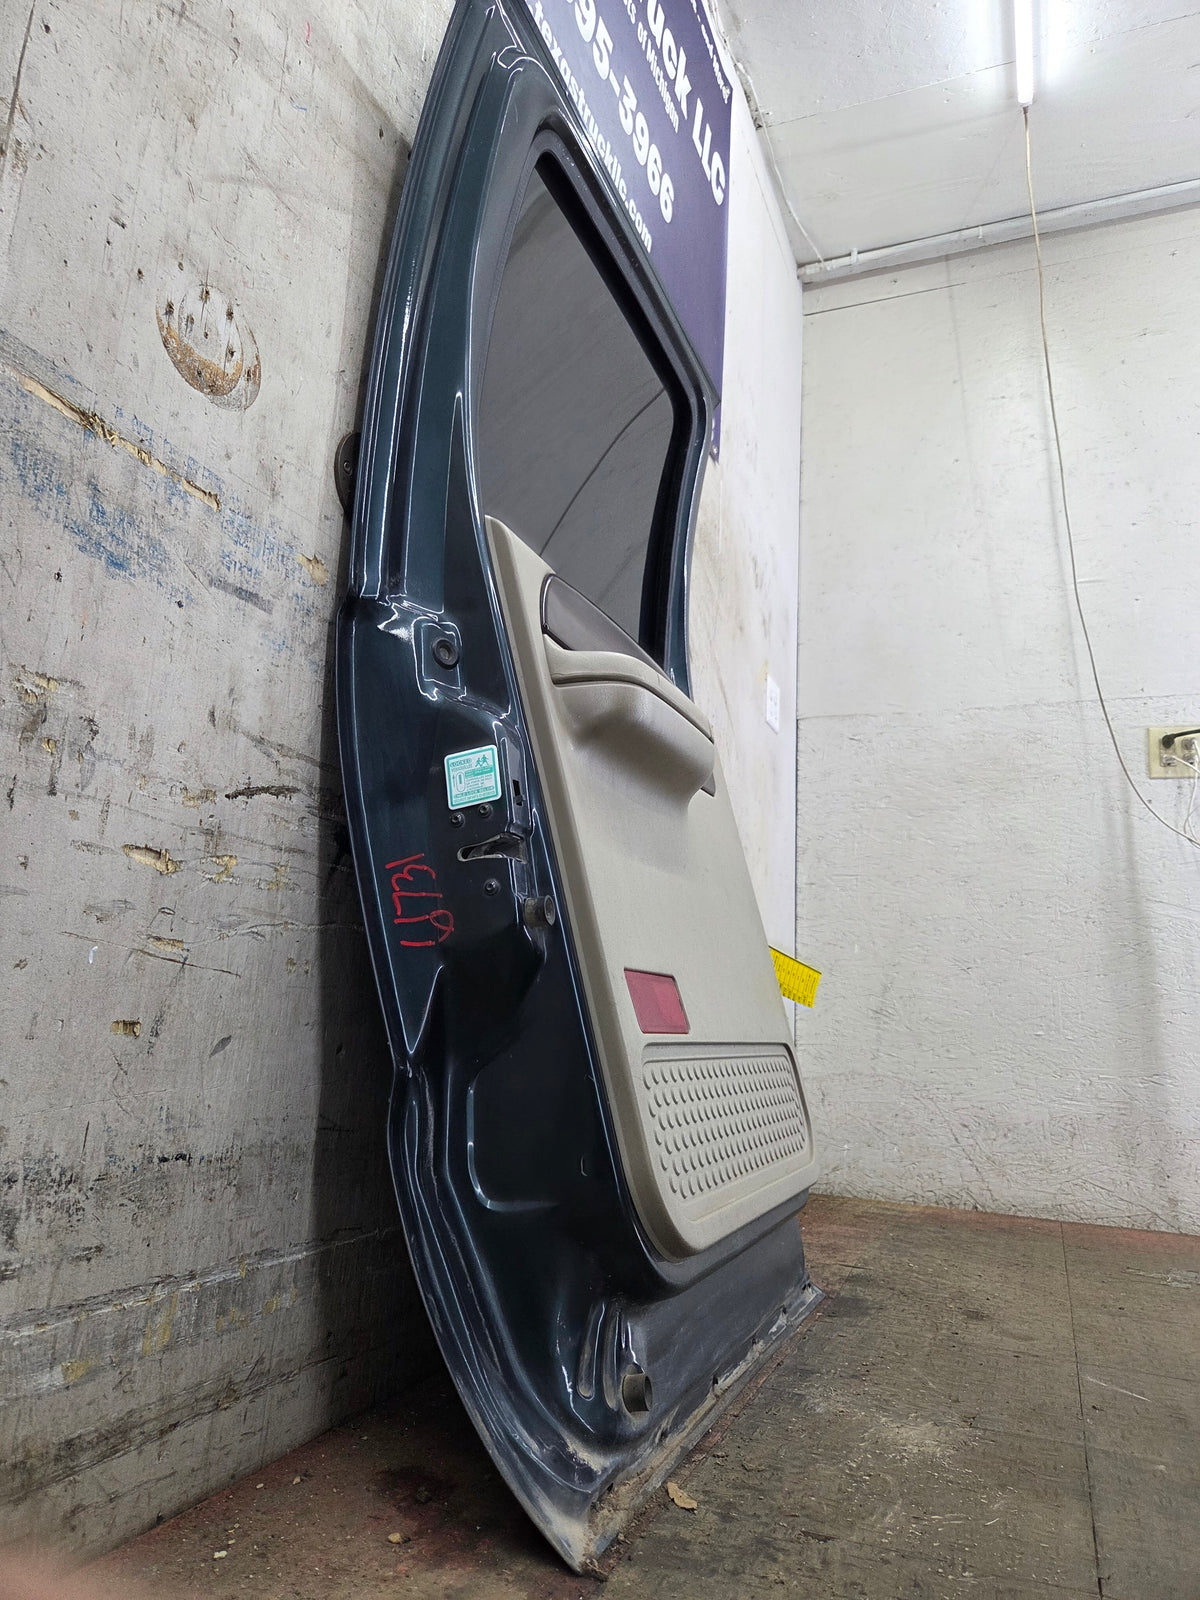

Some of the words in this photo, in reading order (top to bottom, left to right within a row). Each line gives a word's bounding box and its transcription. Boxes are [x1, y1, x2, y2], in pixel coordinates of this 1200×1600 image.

[525, 0, 652, 253] .texastruckllc.com
[566, 0, 675, 224] 95-3966
[638, 21, 648, 51] of
[646, 38, 679, 134] Michigan
[640, 0, 692, 120] uck
[692, 97, 725, 205] LLC
